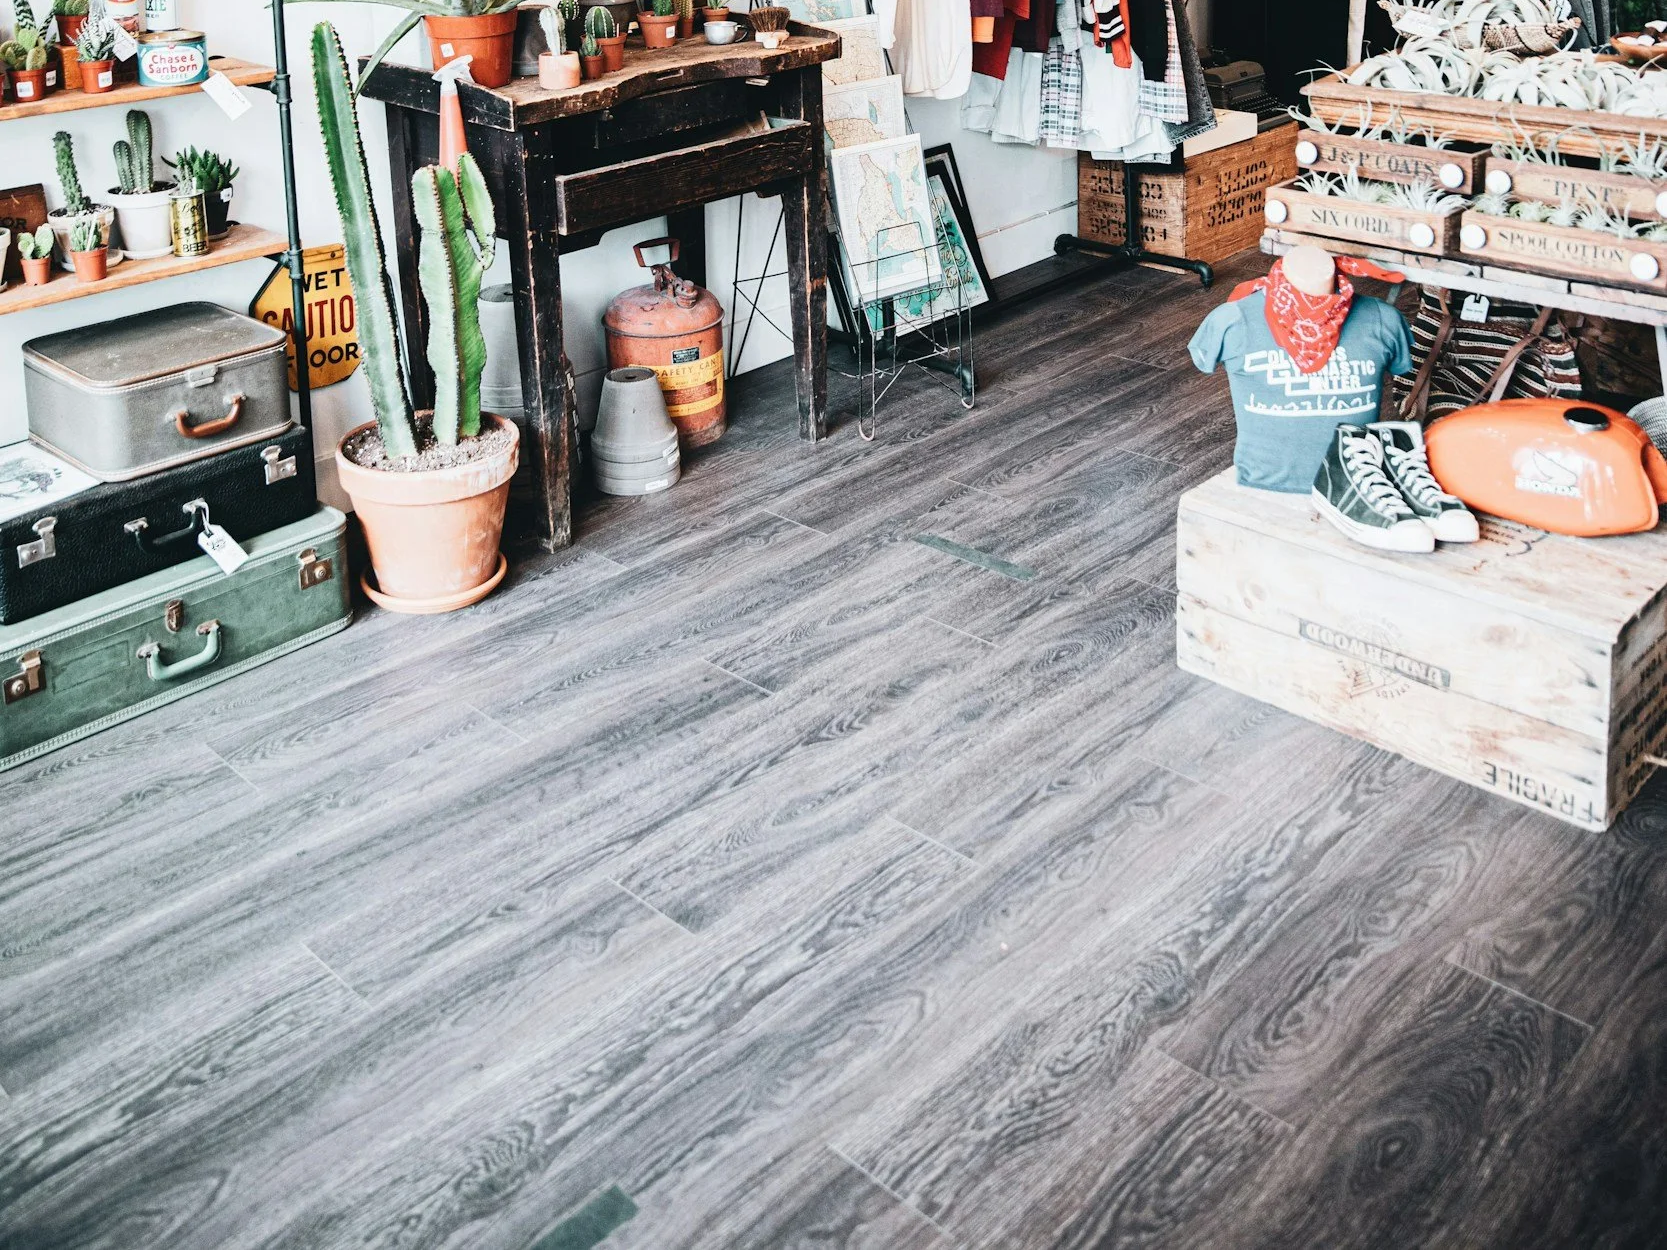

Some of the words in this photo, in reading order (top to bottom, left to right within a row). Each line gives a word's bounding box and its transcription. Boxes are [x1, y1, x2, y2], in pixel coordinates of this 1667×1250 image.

[149, 63, 198, 74] Sanborn
[151, 54, 186, 64] Chase
[1311, 209, 1339, 227] SIX
[1345, 214, 1388, 234] CORD
[183, 242, 207, 252] BEER
[1499, 230, 1548, 249] SPOOL
[1556, 240, 1623, 262] COTTON
[655, 366, 694, 376] SAFETY
[700, 358, 716, 370] CAN
[1305, 621, 1444, 689] UNDERWOOD
[1481, 760, 1601, 824] FRAGILE
